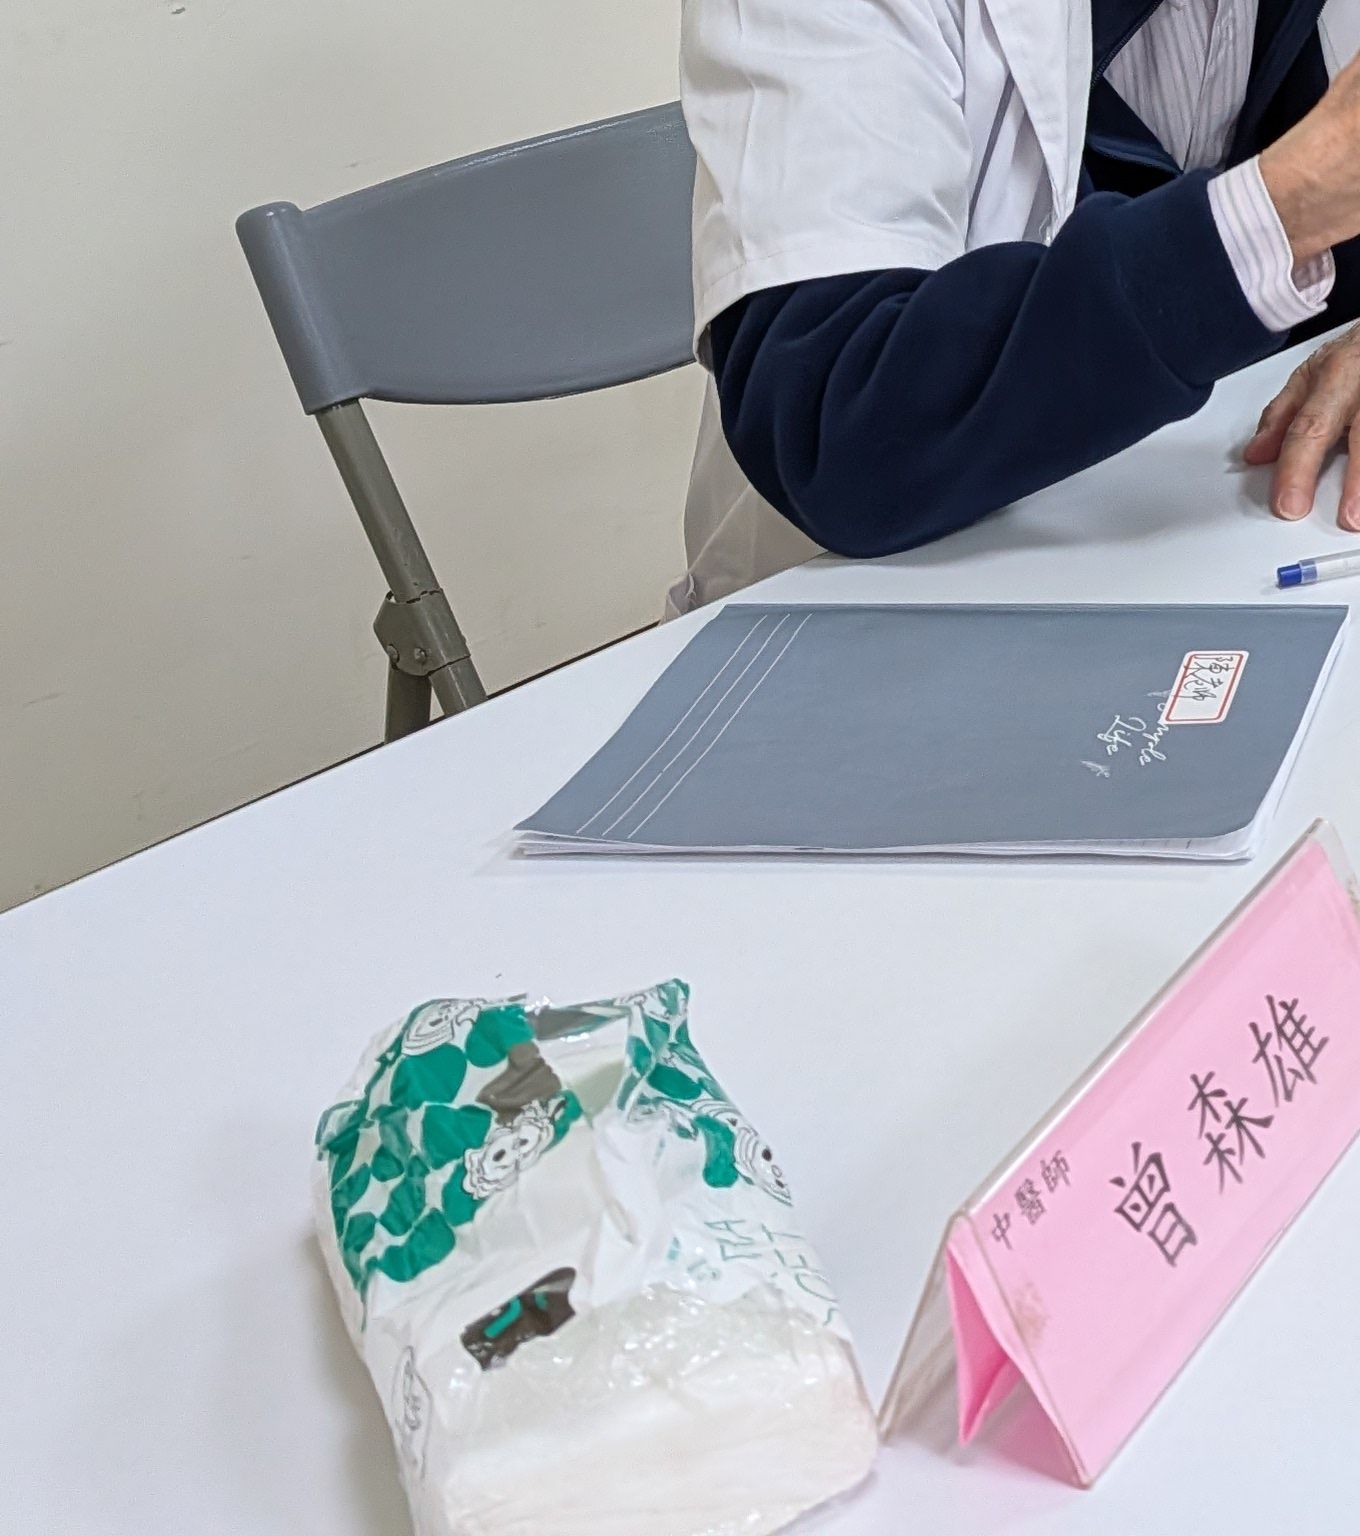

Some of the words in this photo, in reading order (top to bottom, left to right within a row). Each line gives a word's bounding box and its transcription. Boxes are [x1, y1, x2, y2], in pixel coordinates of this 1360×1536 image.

[990, 1150, 1072, 1252] 中醫師
[1109, 994, 1330, 1269] 曾森雄
